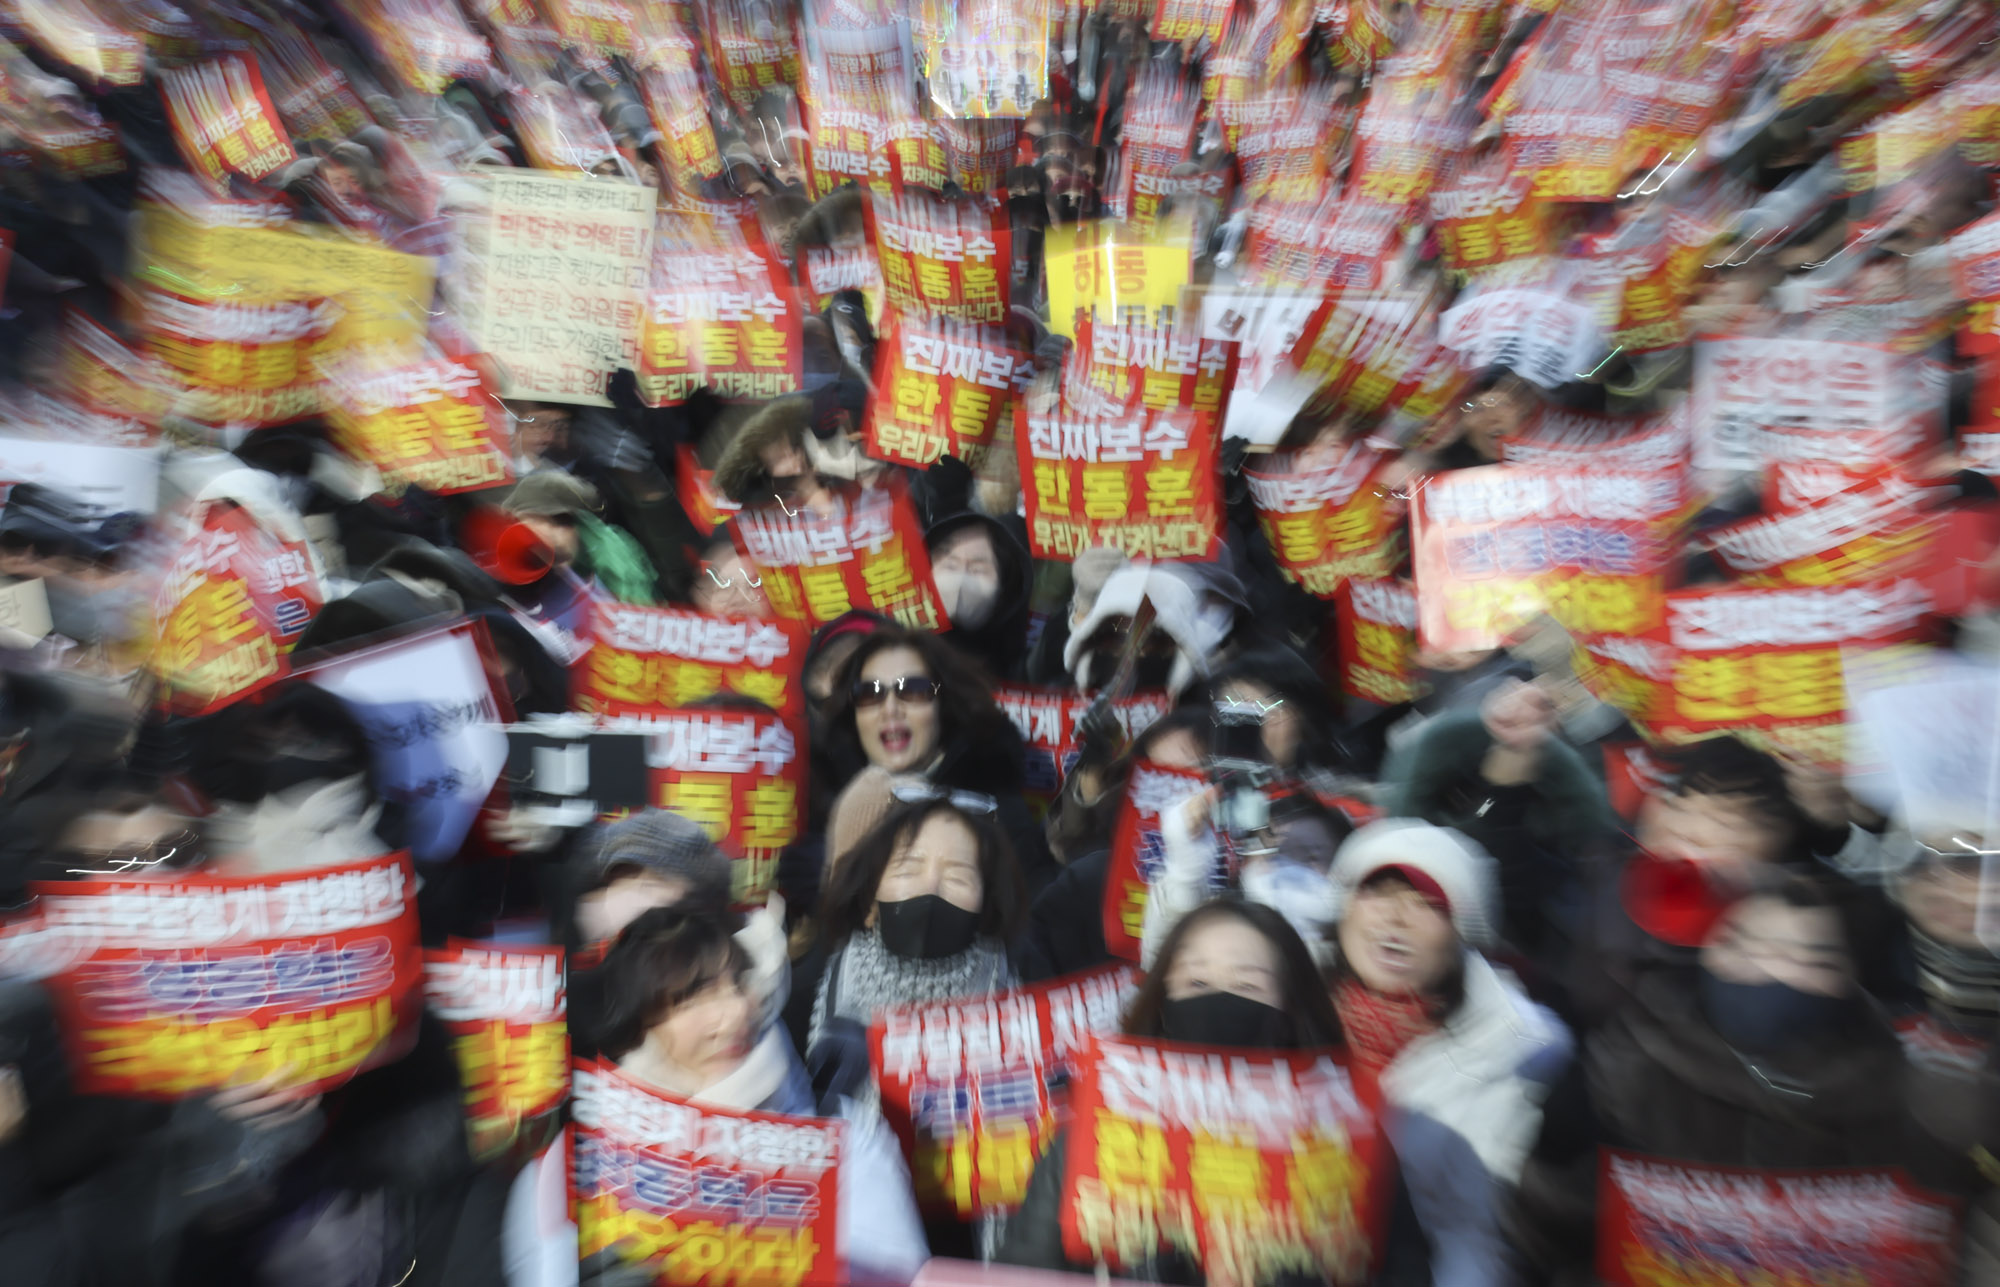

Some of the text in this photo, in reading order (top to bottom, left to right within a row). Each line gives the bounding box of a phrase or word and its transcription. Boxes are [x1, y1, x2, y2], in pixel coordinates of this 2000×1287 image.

[817, 129, 870, 151] 한동
[820, 111, 880, 134] 진짜보
[871, 120, 947, 152] 진짜보수
[813, 149, 892, 177] 진짜보수
[881, 219, 998, 263] 진짜보수
[885, 251, 999, 300] 한동훈
[652, 291, 787, 325] 진짜보수
[653, 326, 788, 369] 한동훈
[904, 334, 1038, 394] 진짜보수
[1092, 329, 1228, 379] 진짜보수
[648, 371, 797, 403] 우리가 지켜낸다
[896, 375, 1000, 438] 한동
[877, 423, 951, 466] 우리가
[1028, 419, 1189, 464] 진짜보수
[1033, 464, 1195, 520] 한동훈
[1033, 516, 1210, 560] 우리가 지켜낸다
[606, 608, 790, 667] 진짜보수
[661, 775, 798, 849] 동훈
[279, 862, 405, 932] 자행한
[881, 996, 1044, 1086] 부당징계
